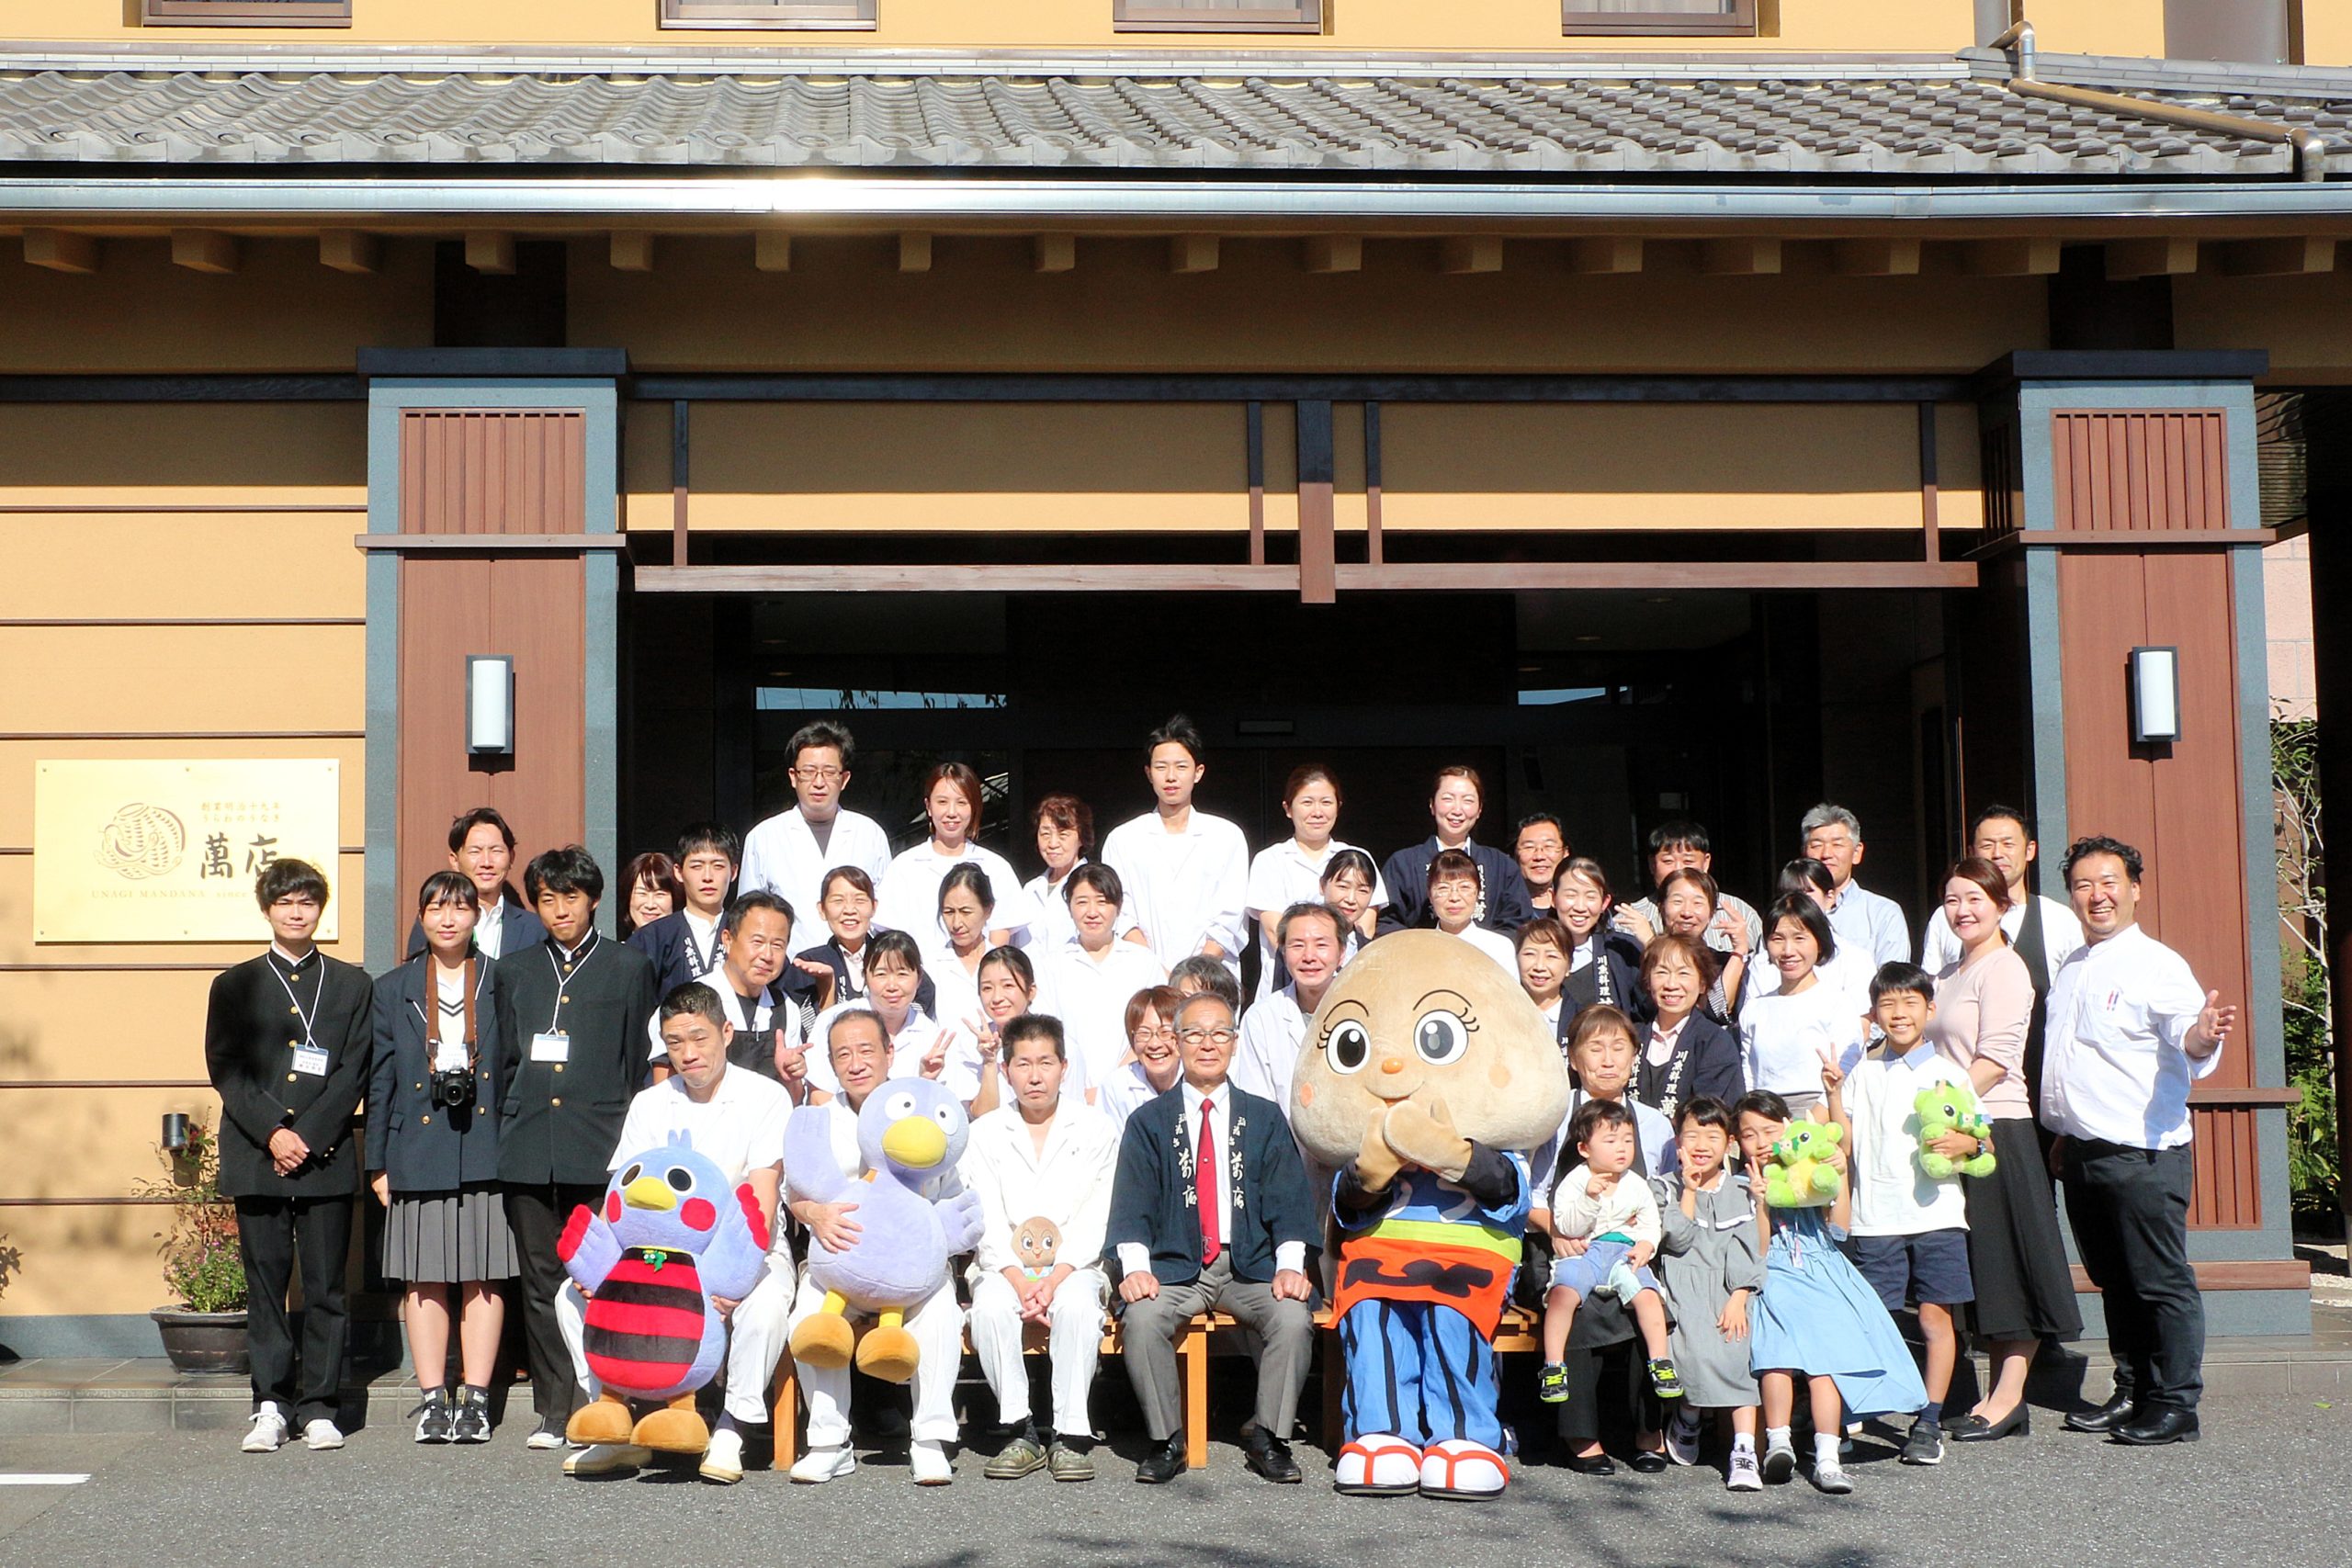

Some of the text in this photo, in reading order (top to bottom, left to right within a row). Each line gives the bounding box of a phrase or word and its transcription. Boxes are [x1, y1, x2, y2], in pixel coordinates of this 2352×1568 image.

[200, 831, 277, 879] 萬店
[91, 890, 133, 898] UNAGI
[139, 890, 206, 898] MANDANA
